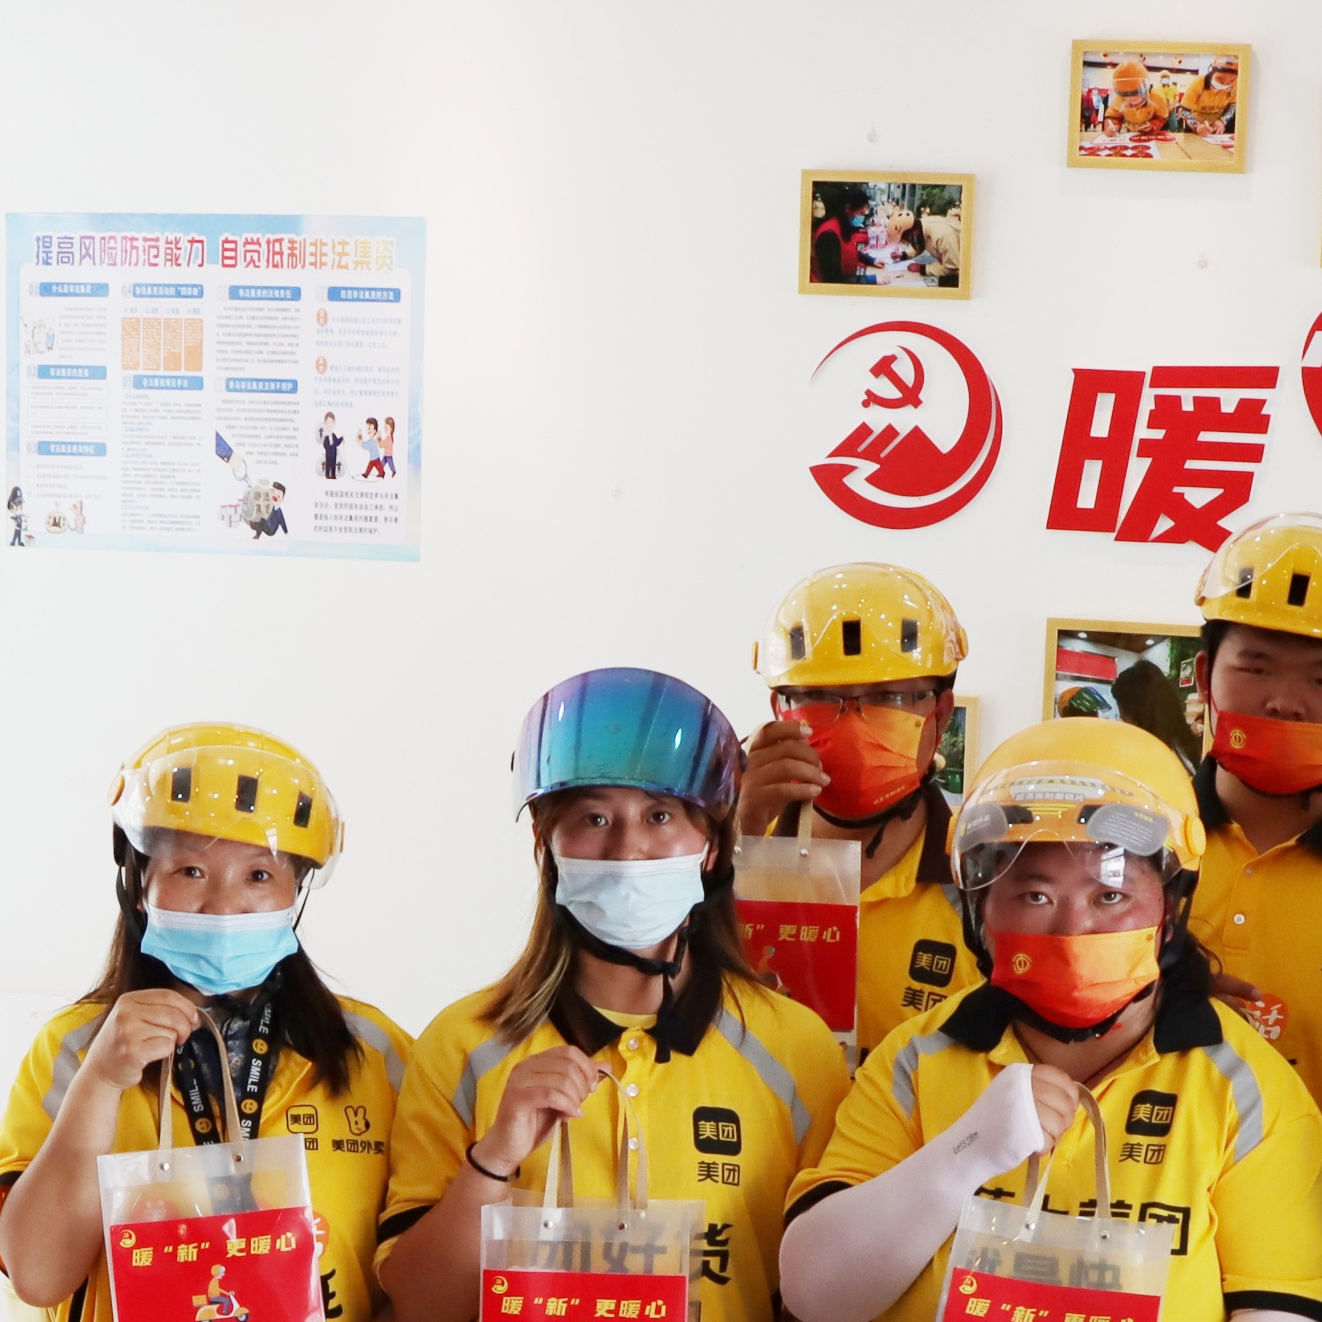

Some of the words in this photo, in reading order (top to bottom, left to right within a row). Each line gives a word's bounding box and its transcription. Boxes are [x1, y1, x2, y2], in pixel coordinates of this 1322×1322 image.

[35, 235, 205, 268] 提高风险防范能力
[219, 237, 395, 271] 自觉抵制非法集资
[915, 952, 951, 974] 美团
[247, 1058, 262, 1092] SMILE
[189, 1079, 204, 1112] SMIL
[290, 1113, 315, 1125] 美团
[1132, 1101, 1175, 1124] 美团
[698, 1120, 737, 1142] 美团
[305, 1138, 319, 1150] 团
[332, 1139, 386, 1155] 美团外卖
[1118, 1142, 1167, 1165] 美团
[697, 1161, 740, 1186] 美团
[132, 1232, 297, 1267] 暖“新”更暖心
[501, 1296, 667, 1319] 暖“新”更暖心
